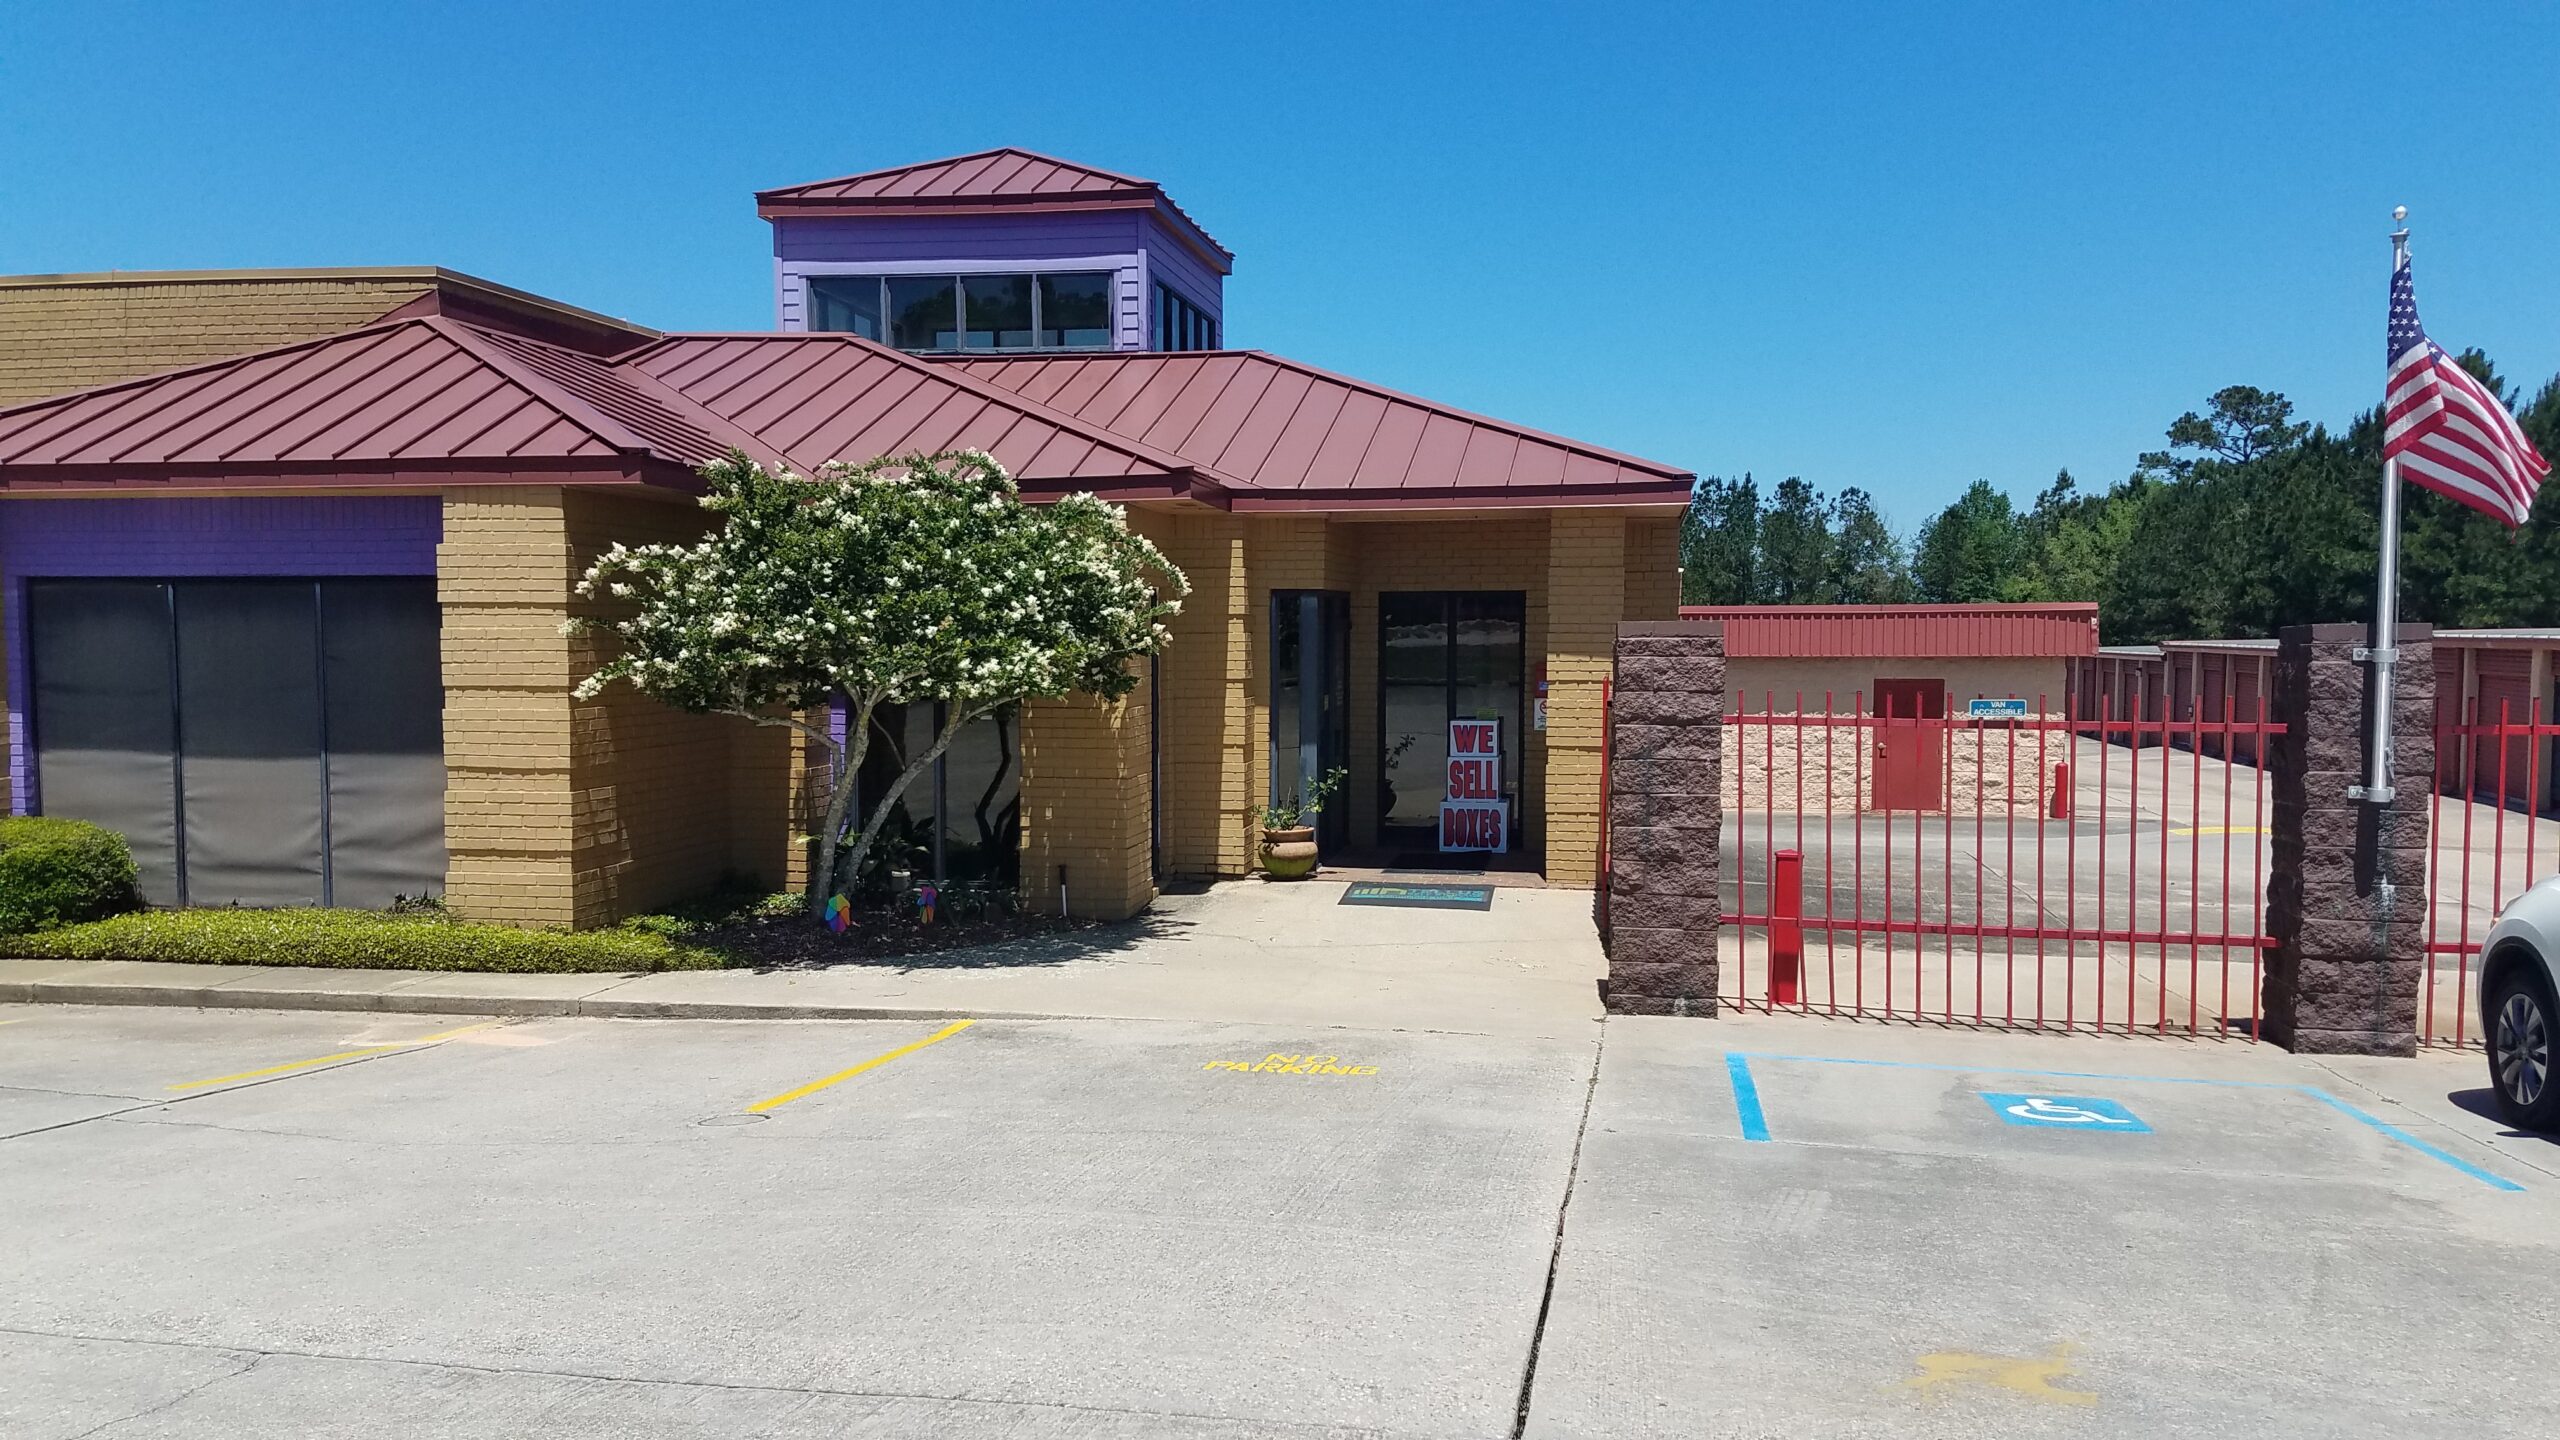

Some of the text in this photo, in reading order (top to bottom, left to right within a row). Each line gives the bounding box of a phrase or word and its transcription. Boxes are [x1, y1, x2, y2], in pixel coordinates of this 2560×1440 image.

[1973, 708, 2023, 716] ACCESSIBLE
[1453, 725, 1494, 753] WE
[1450, 760, 1497, 799] SELL
[1444, 808, 1501, 848] BOXES
[1203, 1060, 1380, 1075] PARKING
[1265, 1053, 1339, 1064] NO
